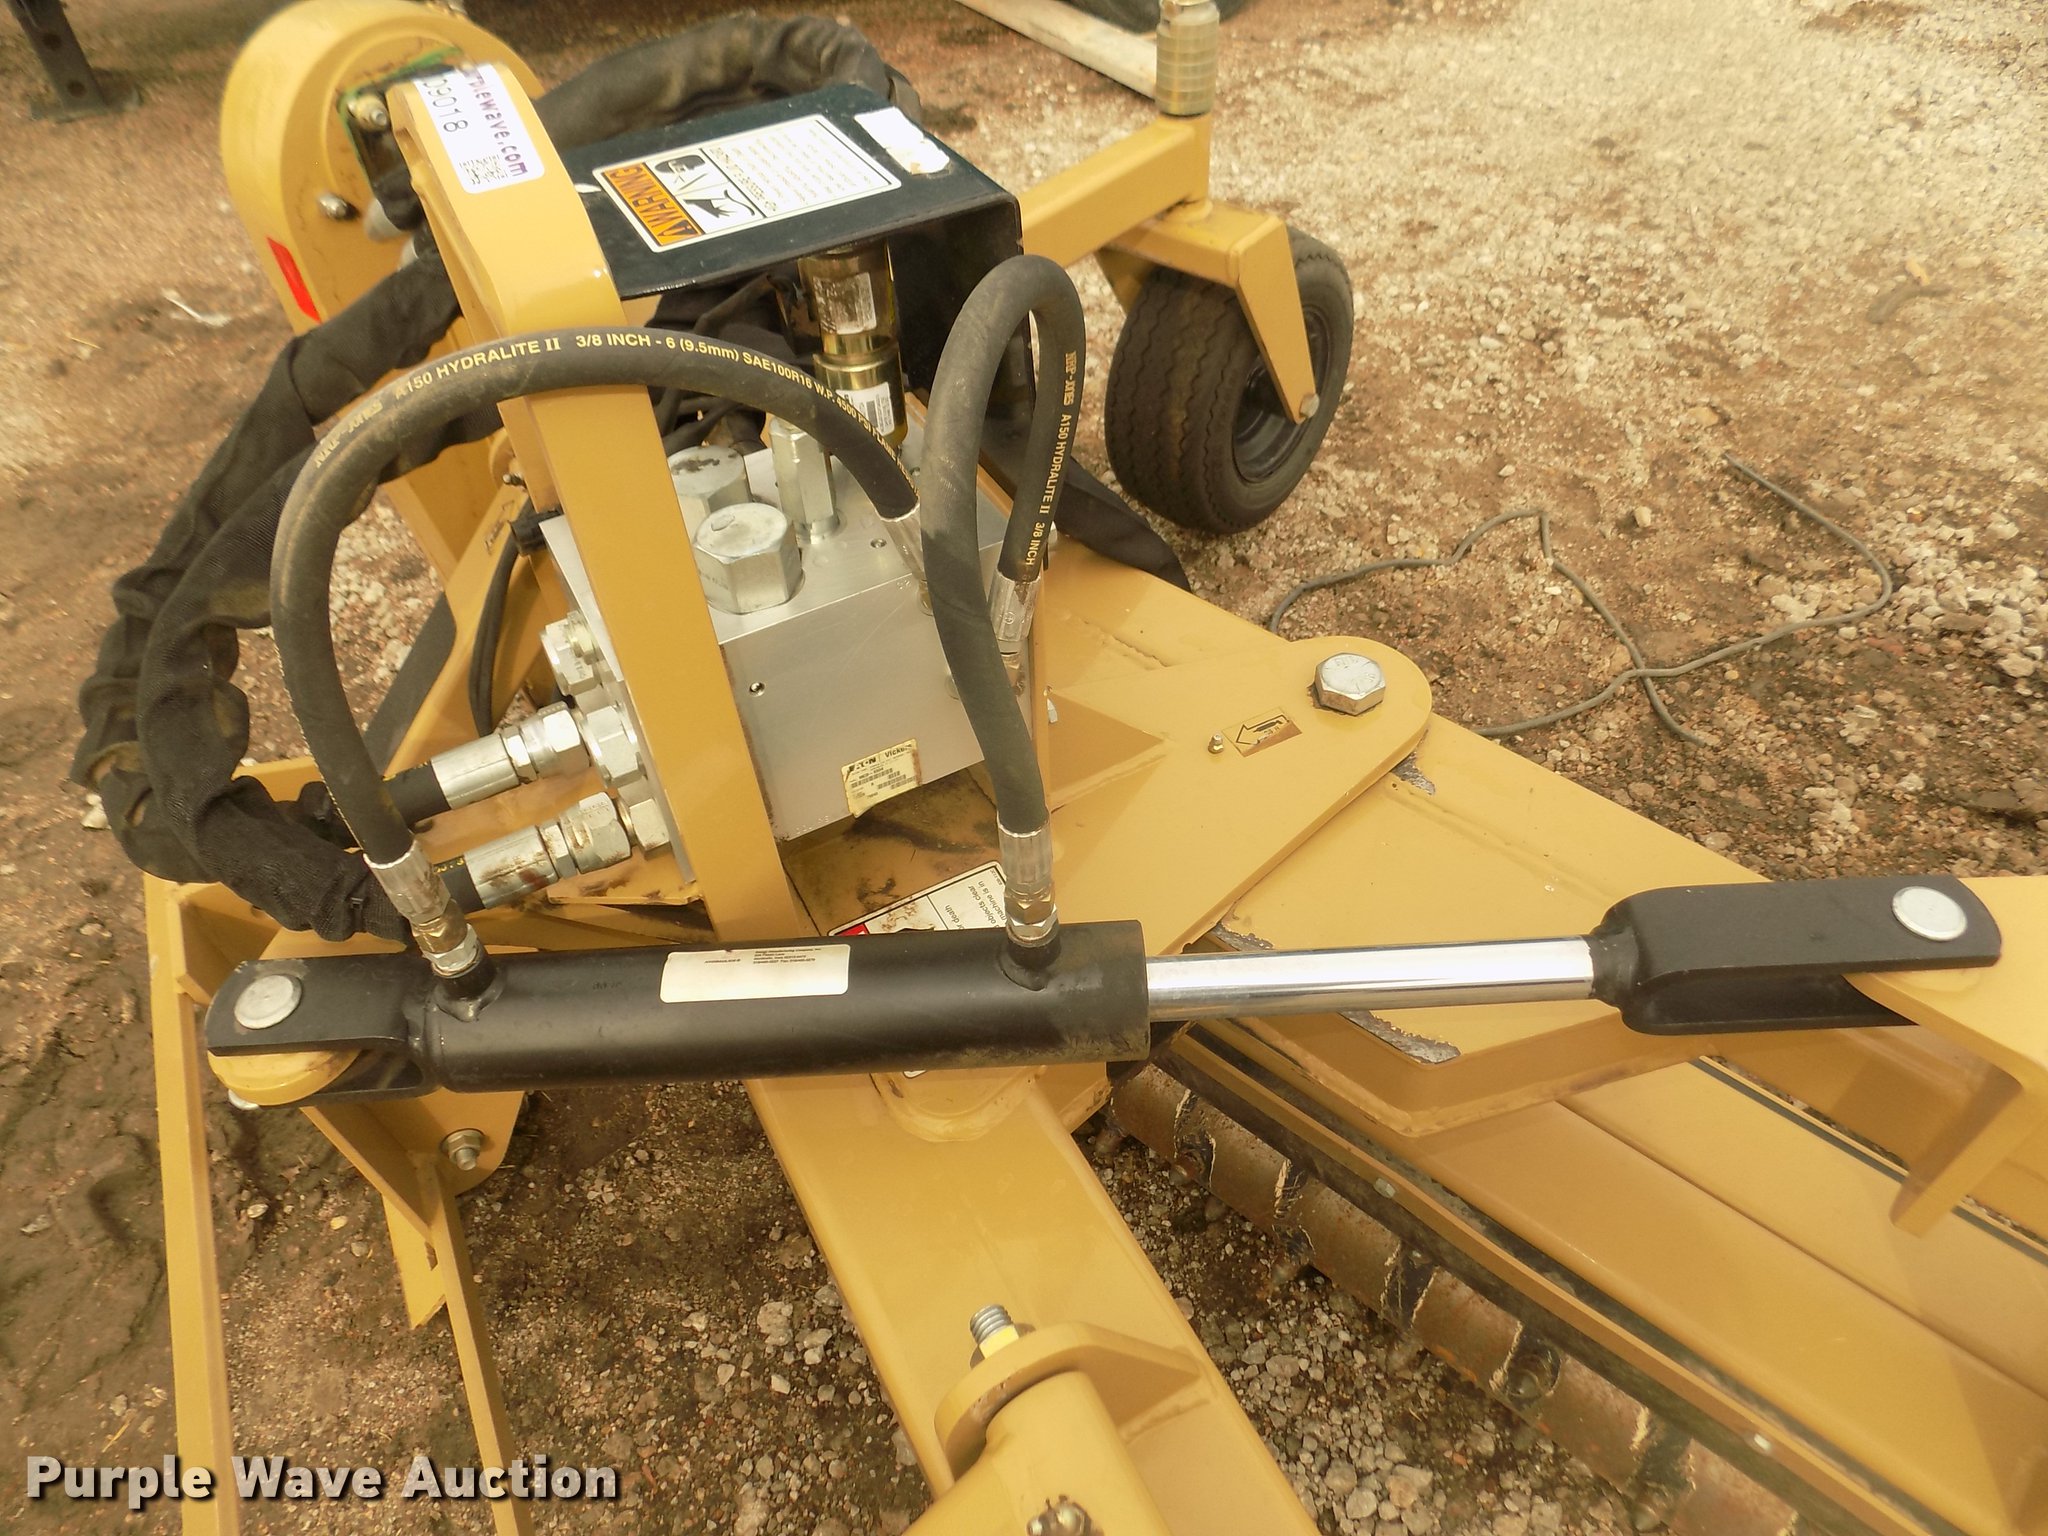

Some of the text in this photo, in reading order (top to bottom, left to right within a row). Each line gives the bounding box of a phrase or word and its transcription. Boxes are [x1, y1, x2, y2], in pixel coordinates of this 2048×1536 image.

[609, 164, 677, 228] WARNING
[394, 370, 434, 400] A150
[436, 340, 541, 380] HYDRALITE
[544, 337, 562, 352] II
[575, 334, 603, 348] 3/8
[606, 333, 651, 347] INCH
[665, 336, 676, 349] 6
[679, 337, 740, 362] (9.5mm)
[742, 351, 813, 389] SAE100R16
[836, 396, 857, 419] 4500
[1057, 414, 1072, 440] A150
[1042, 441, 1067, 503] HYDRALITE
[1039, 505, 1051, 514] II
[1032, 521, 1046, 538] 3/8
[1025, 538, 1041, 566] INCH
[967, 885, 982, 901] clear
[945, 904, 960, 924] death
[978, 900, 997, 925] objects
[987, 894, 1007, 921] machine
